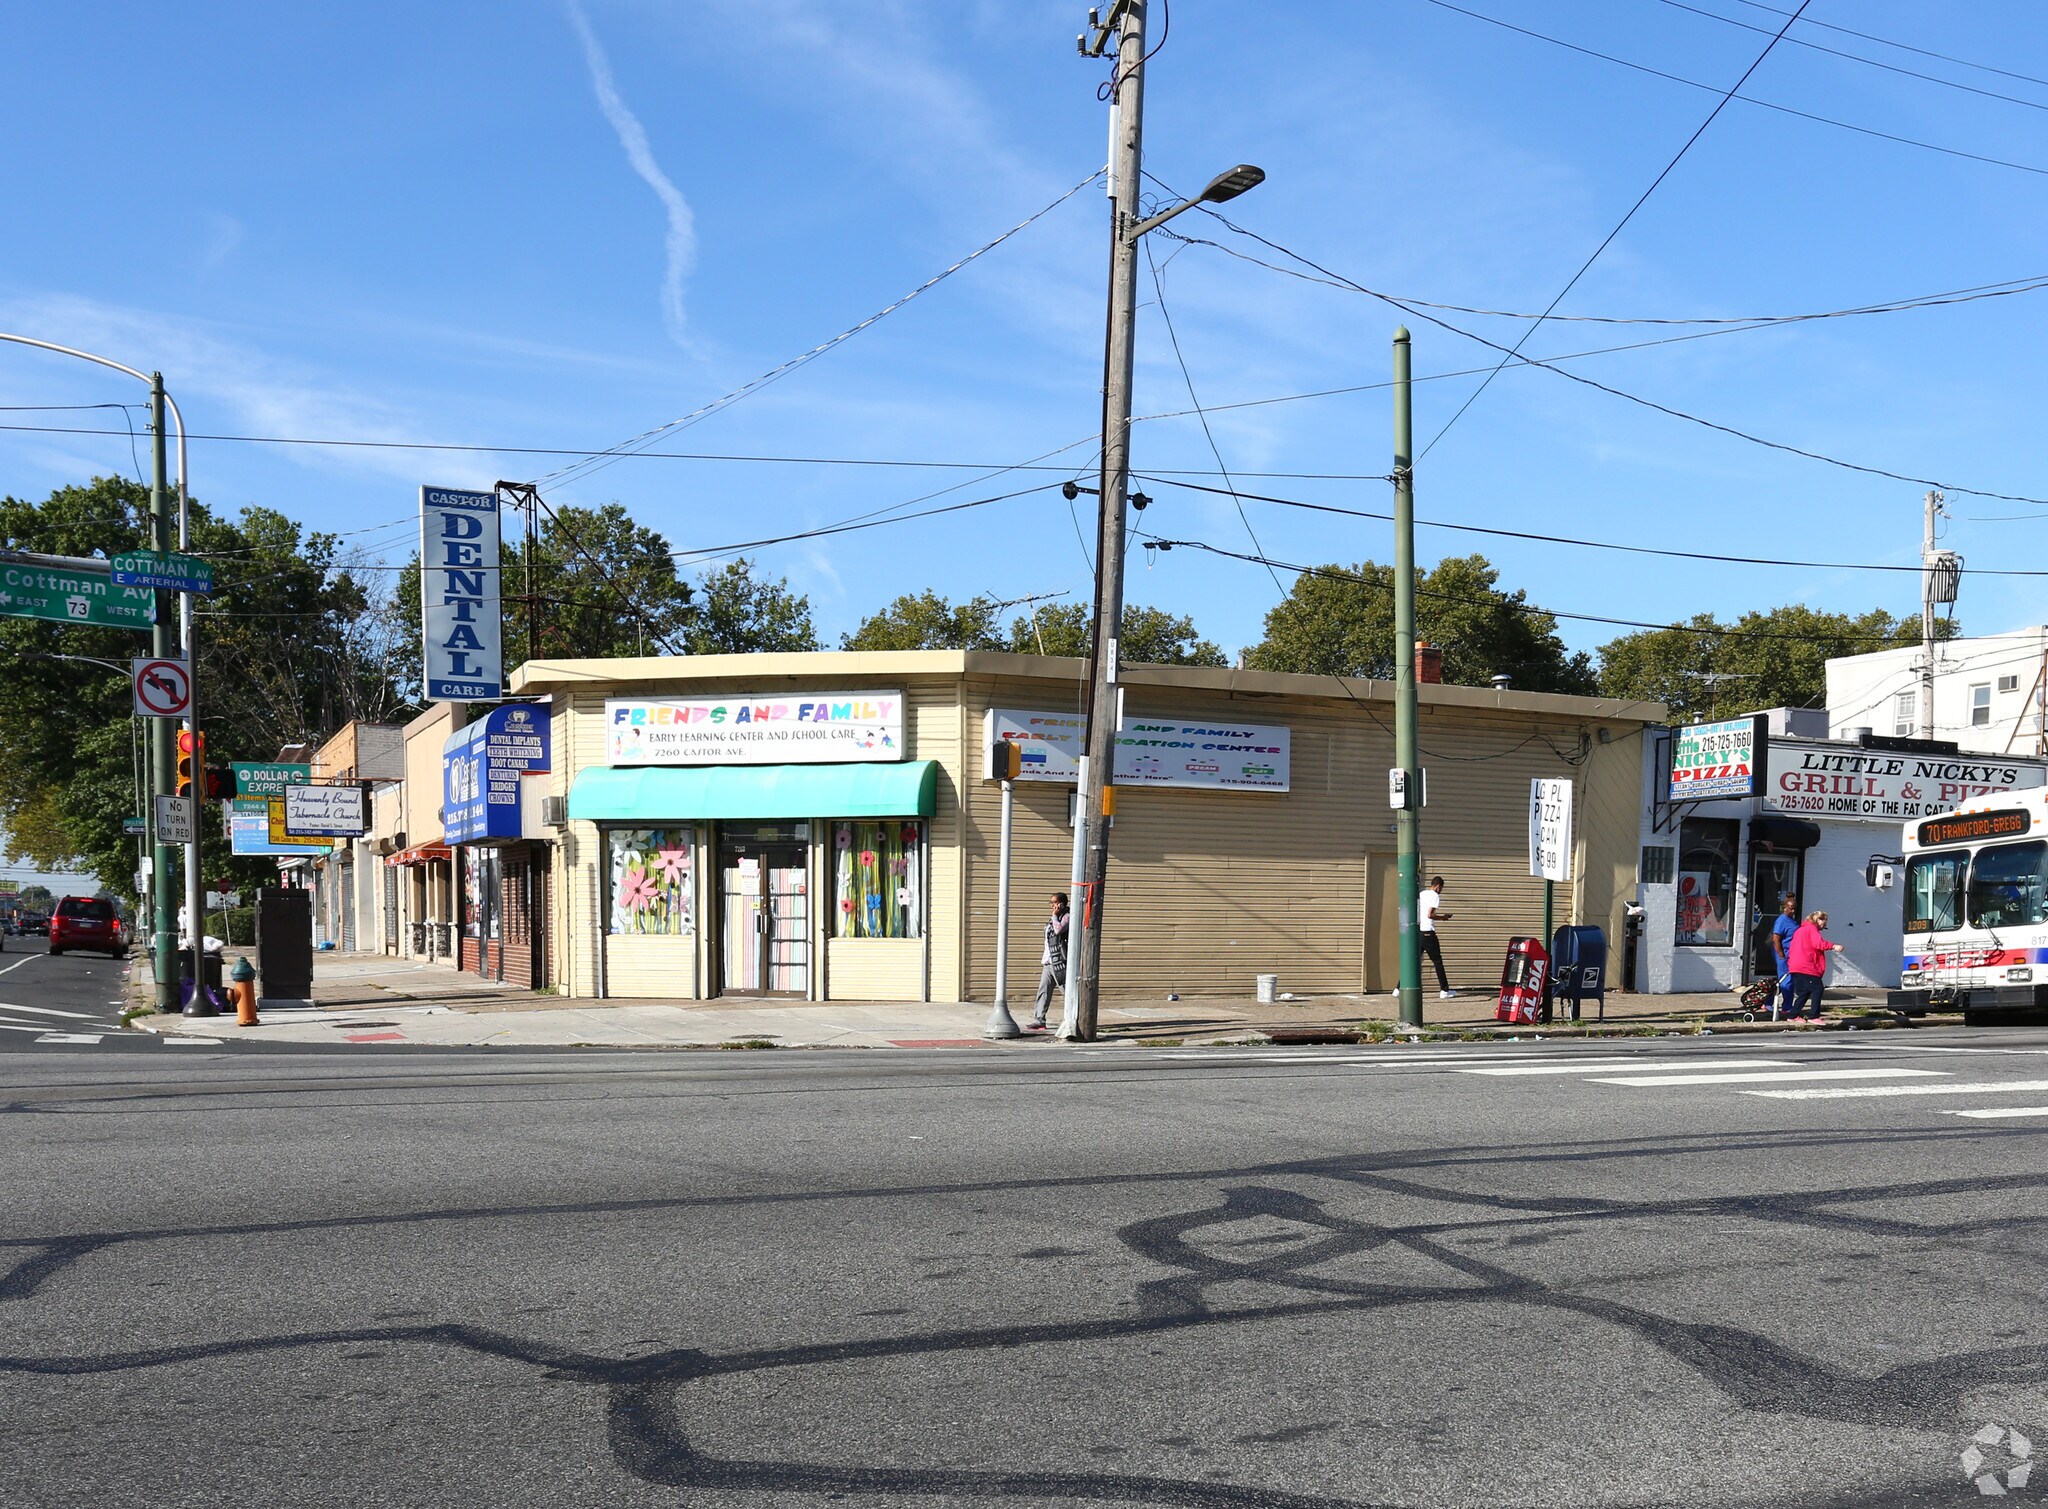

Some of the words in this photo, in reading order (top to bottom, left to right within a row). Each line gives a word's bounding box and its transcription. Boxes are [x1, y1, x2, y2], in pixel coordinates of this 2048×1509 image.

[428, 492, 492, 508] CASTOR
[114, 557, 188, 576] COTTMAN
[195, 569, 209, 580] AV
[5, 569, 106, 596] Cottman
[117, 573, 125, 583] E
[134, 576, 189, 589] ARTERIAL
[198, 581, 208, 591] W
[440, 512, 486, 678] DENTAL
[16, 596, 48, 608] EAST
[68, 602, 87, 616] 73
[106, 605, 138, 617] WEST
[441, 684, 485, 697] CARE
[614, 706, 728, 726] FRIENDS
[735, 705, 789, 725] AND
[798, 701, 894, 723] FAMILY
[490, 735, 511, 745] DENTAL
[513, 736, 541, 746] IMPLANTS
[649, 732, 676, 743] EARLY
[680, 732, 726, 743] LEARNING
[729, 731, 764, 742] CENTER
[767, 731, 788, 740] AND
[791, 729, 828, 740] SCHOOL
[831, 728, 856, 739] CARE
[1132, 725, 1176, 733] AND
[1182, 727, 1255, 739] FAMILY
[1702, 731, 1751, 751] 215-725-7660
[489, 747, 507, 755] TEETH
[509, 748, 540, 757] WHITENING
[655, 748, 680, 757] 7260
[684, 747, 721, 756] CASTOR
[1002, 732, 1072, 741] EARLY
[1201, 743, 1281, 754] CENTER
[490, 758, 506, 767] ROOT
[508, 759, 528, 768] CANALS
[1673, 748, 1750, 768] NICKY'S
[253, 770, 289, 781] DOLLAR
[490, 770, 517, 779] DENTURES
[1672, 764, 1750, 782] PIZZA
[1801, 753, 1904, 775] LITTLE
[1913, 762, 2017, 784] NICKY'S
[490, 782, 516, 791] BRIDGES
[1535, 781, 1545, 800] LG
[1780, 772, 1885, 797] GRILL
[1901, 782, 1922, 799] &
[1938, 783, 2009, 802] PIZ
[170, 801, 182, 812] NO
[288, 791, 330, 806] Heavenly
[332, 792, 359, 804] Bound
[489, 794, 513, 802] CROWNS
[1780, 795, 1824, 810] 725-7620
[1828, 798, 1857, 811] HOME
[1863, 800, 1876, 813] OF
[1882, 801, 1898, 814] THE
[1904, 803, 1920, 816] FAT
[1925, 805, 1944, 816] CAT
[165, 815, 186, 825] TURN
[289, 806, 331, 819] Tabernacle
[333, 807, 361, 820] Church
[1534, 802, 1561, 823] PIZZA
[161, 826, 172, 837] ON
[176, 828, 189, 838] RED
[1927, 824, 1940, 842] 70
[1942, 815, 2022, 839] FRANKFORD-GREGG
[1528, 960, 1545, 992] DÍA
[1523, 996, 1537, 1021] AL
